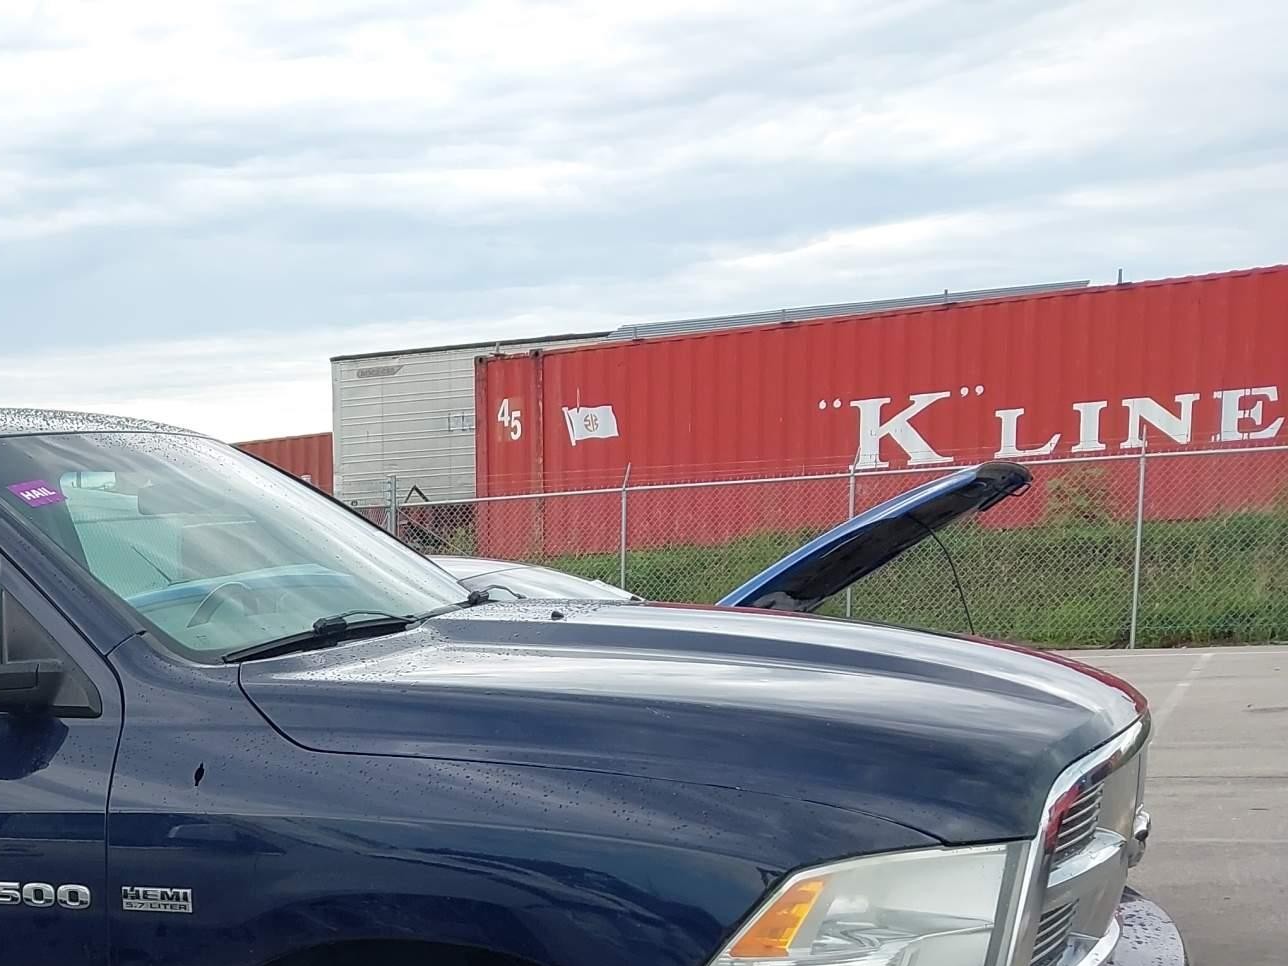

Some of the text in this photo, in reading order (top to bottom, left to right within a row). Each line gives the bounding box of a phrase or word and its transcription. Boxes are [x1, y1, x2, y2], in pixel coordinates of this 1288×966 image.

[497, 398, 522, 440] 45
[993, 386, 1285, 459] LINE
[19, 486, 57, 501] HAIL
[122, 887, 190, 902] HEMI
[125, 901, 187, 911] 5.7 LITER
